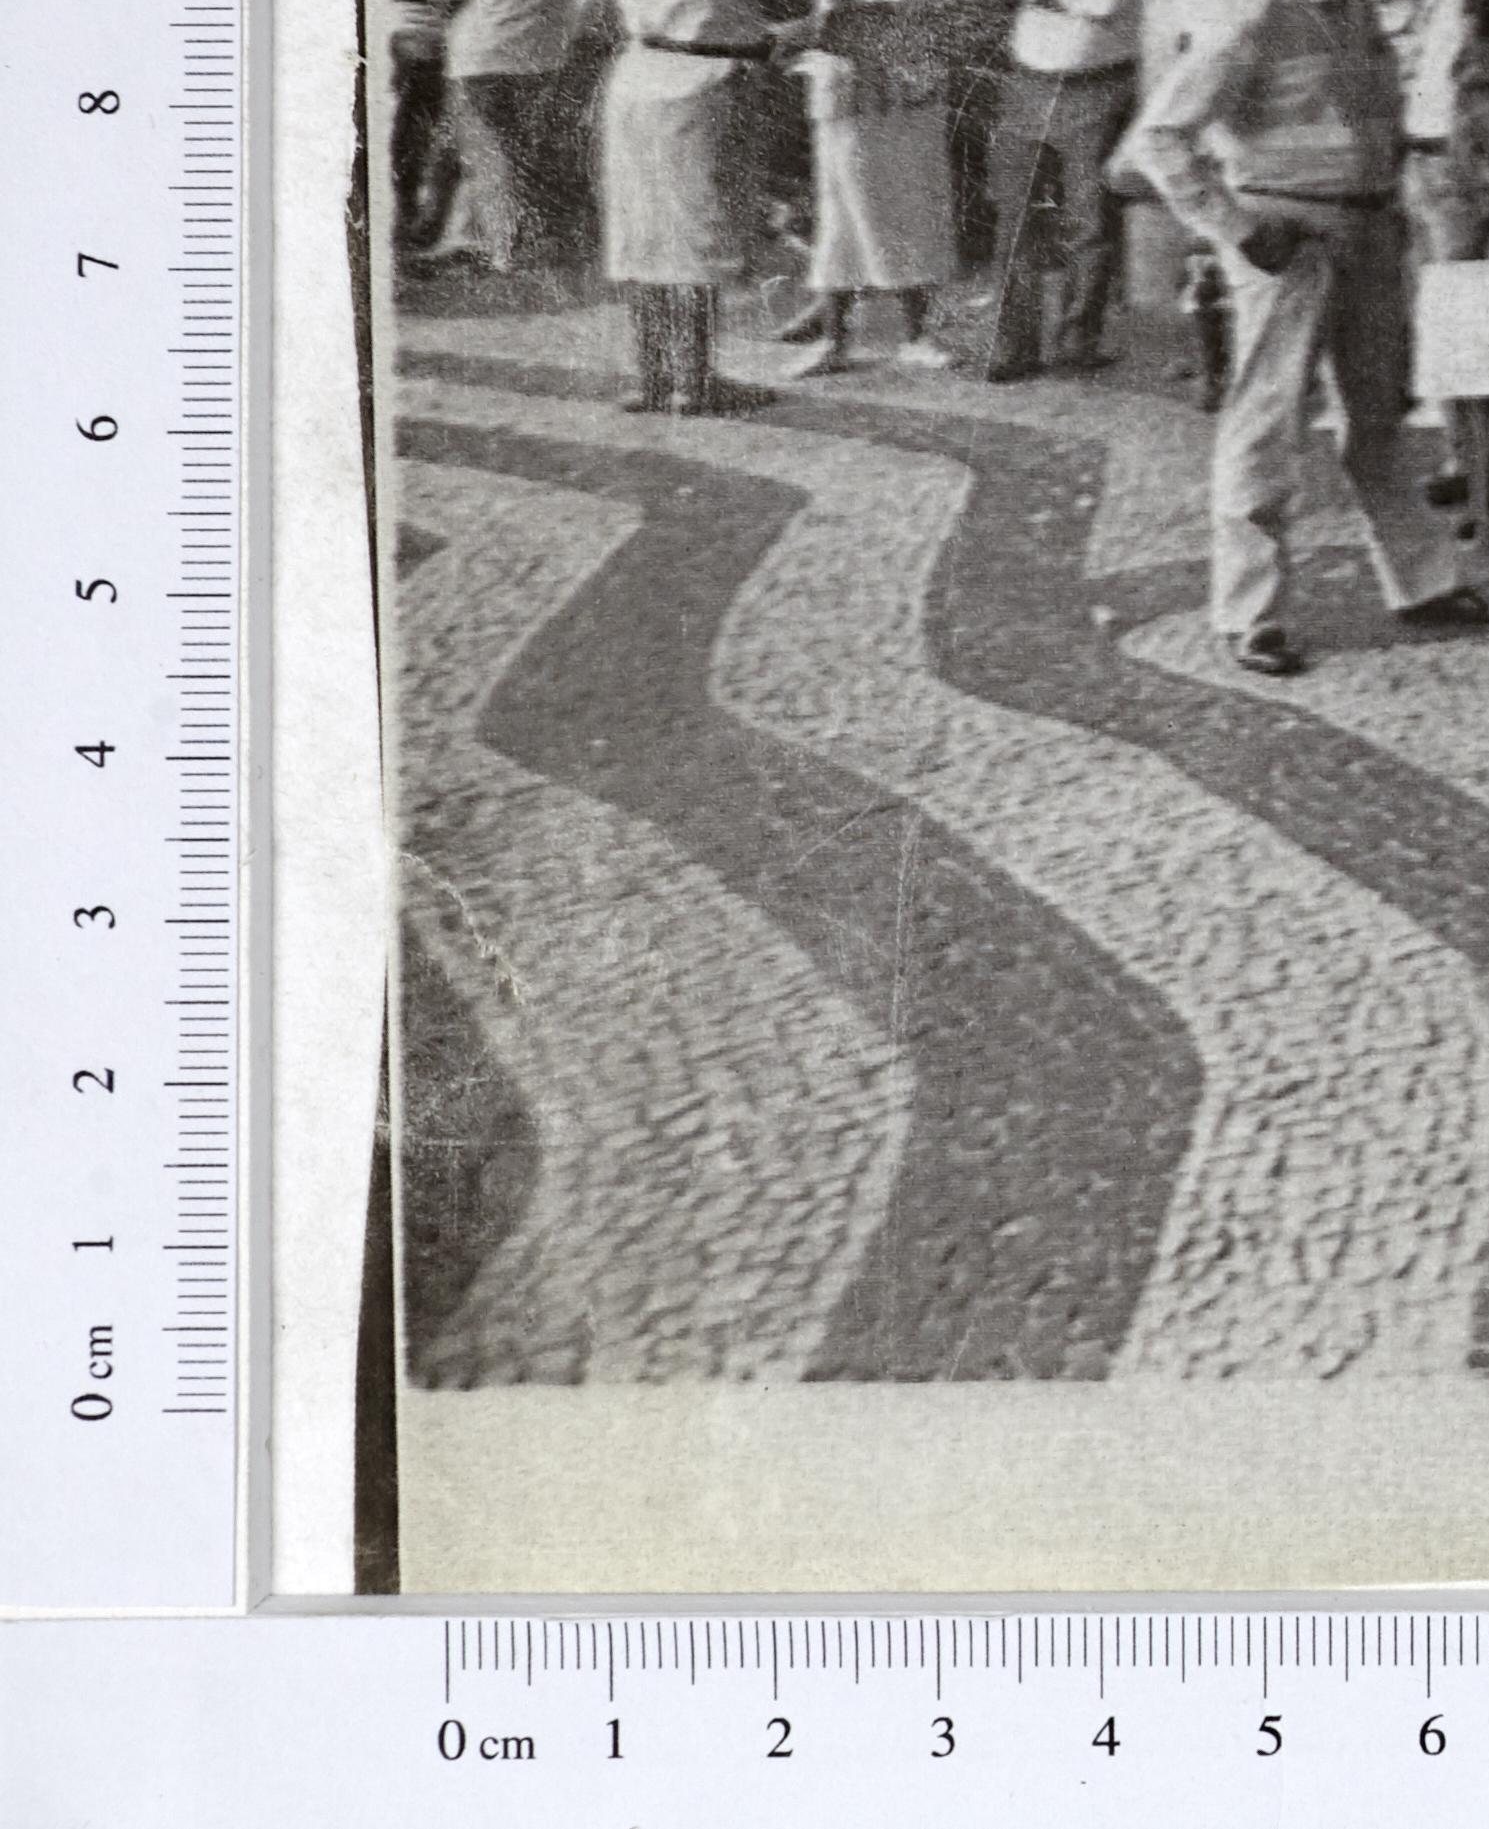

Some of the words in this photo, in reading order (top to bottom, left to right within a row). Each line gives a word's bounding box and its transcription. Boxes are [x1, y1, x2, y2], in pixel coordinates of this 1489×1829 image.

[78, 89, 121, 116] 8
[77, 252, 120, 278] 7
[76, 414, 119, 443] 6
[75, 578, 118, 604] 5
[74, 740, 116, 769] 4
[73, 905, 116, 930] 3
[72, 1068, 115, 1094] 2
[72, 1234, 114, 1253] 1
[89, 1325, 114, 1380] cm
[70, 1393, 113, 1422] 0
[437, 1719, 467, 1761] 0
[479, 1736, 535, 1761] cm
[605, 1718, 625, 1759] 1
[766, 1717, 793, 1759] 2
[931, 1716, 956, 1758] 3
[1091, 1715, 1121, 1757] 4
[1256, 1714, 1283, 1757] 5
[1418, 1714, 1447, 1756] 6
